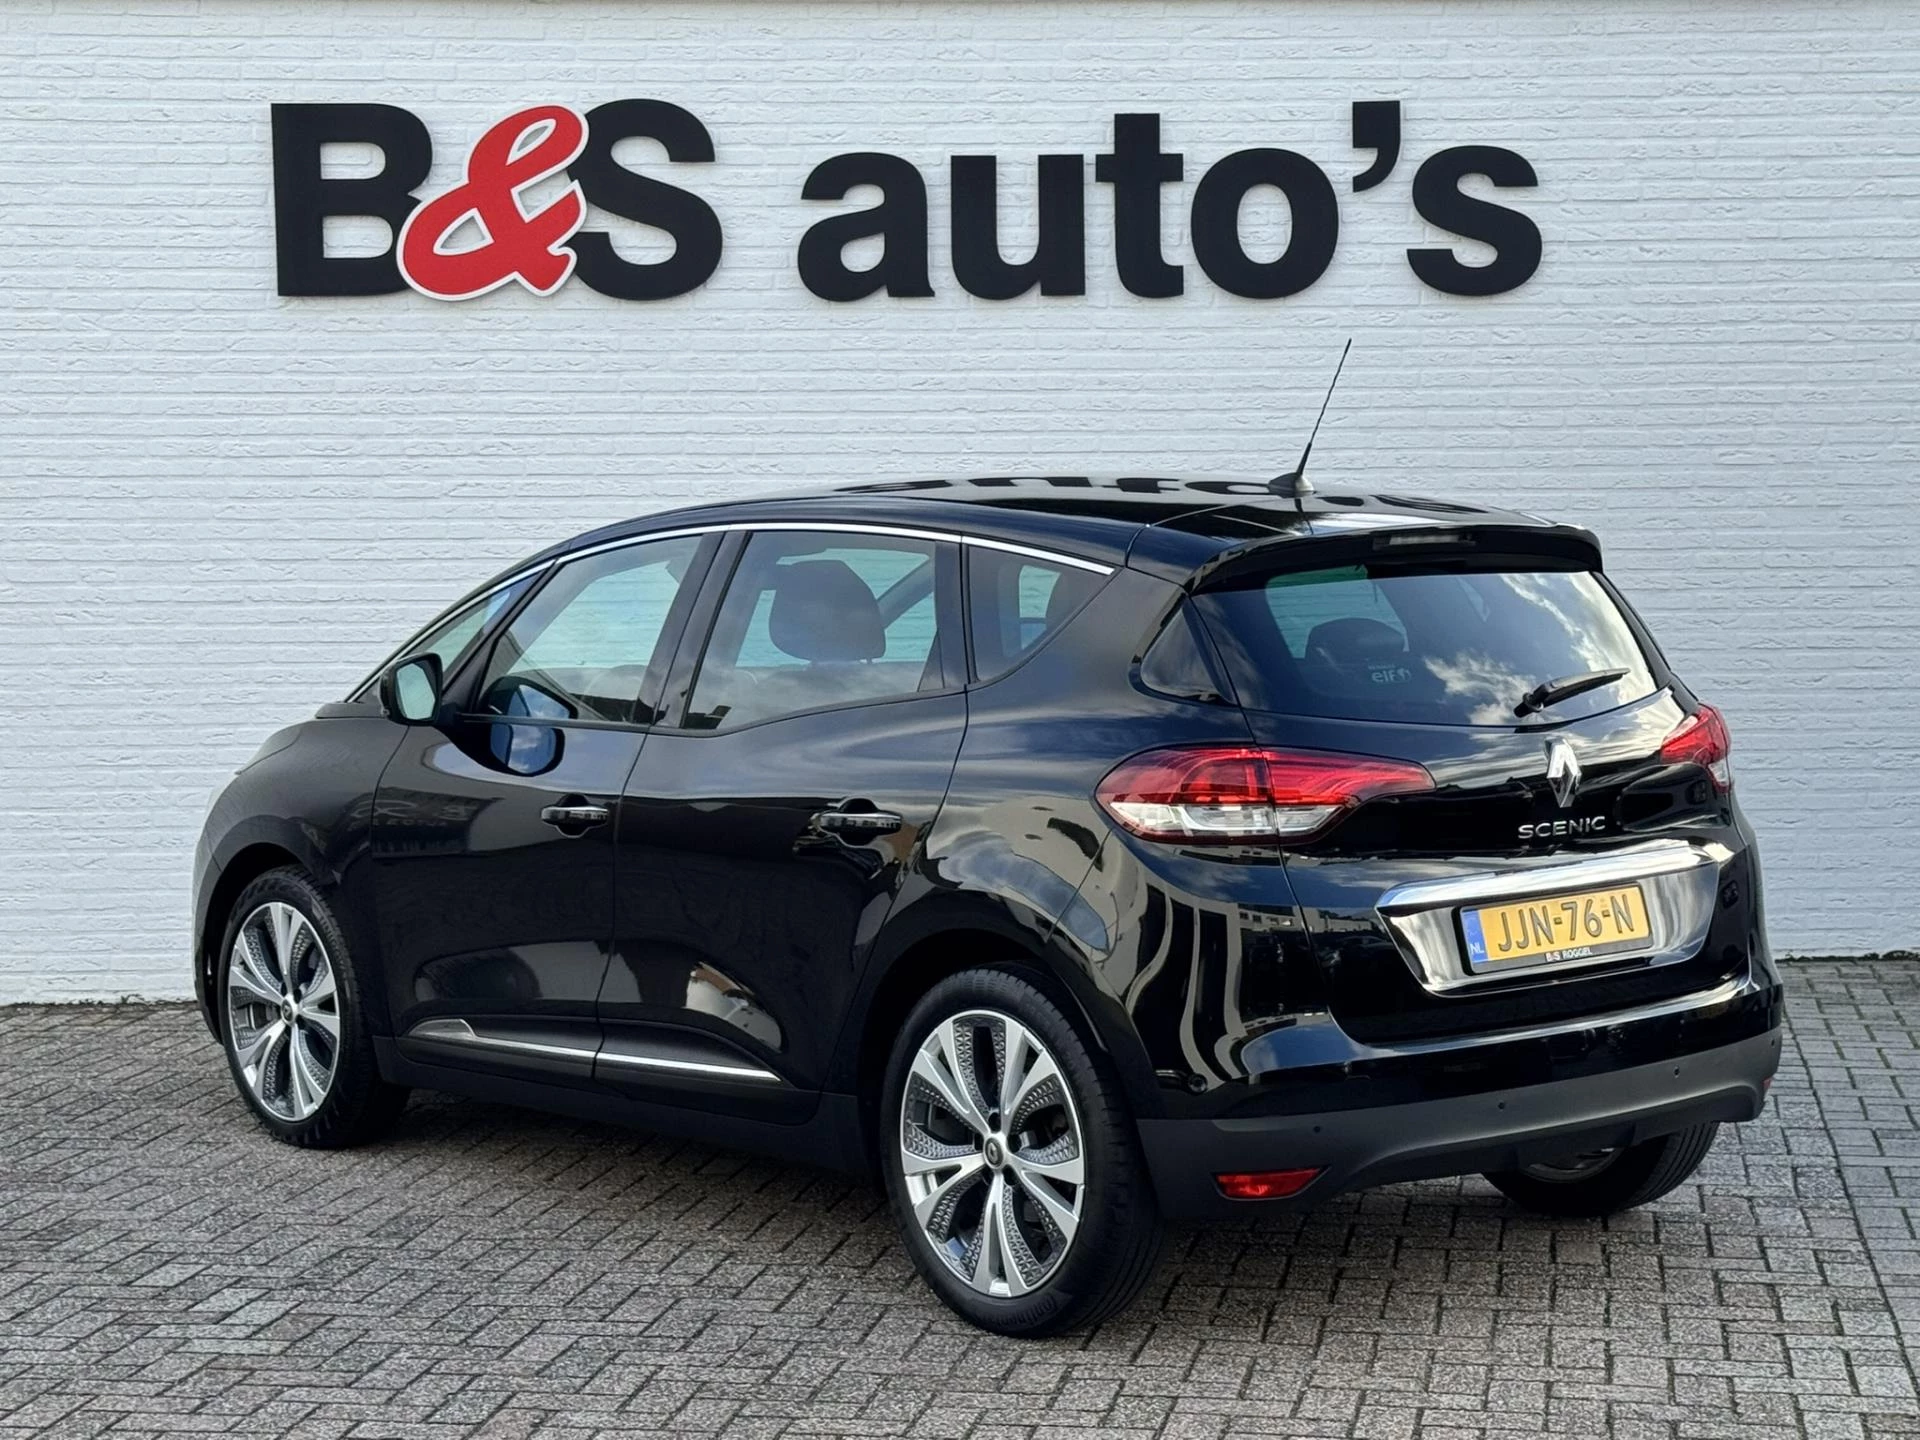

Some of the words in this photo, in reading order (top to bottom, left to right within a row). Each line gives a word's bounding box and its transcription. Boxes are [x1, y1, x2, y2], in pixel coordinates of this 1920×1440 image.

[271, 98, 723, 301] B&S
[797, 101, 1543, 300] auto's
[1517, 816, 1606, 839] SCENIC
[1498, 894, 1635, 952] JJN-76-N
[1470, 942, 1485, 955] NL
